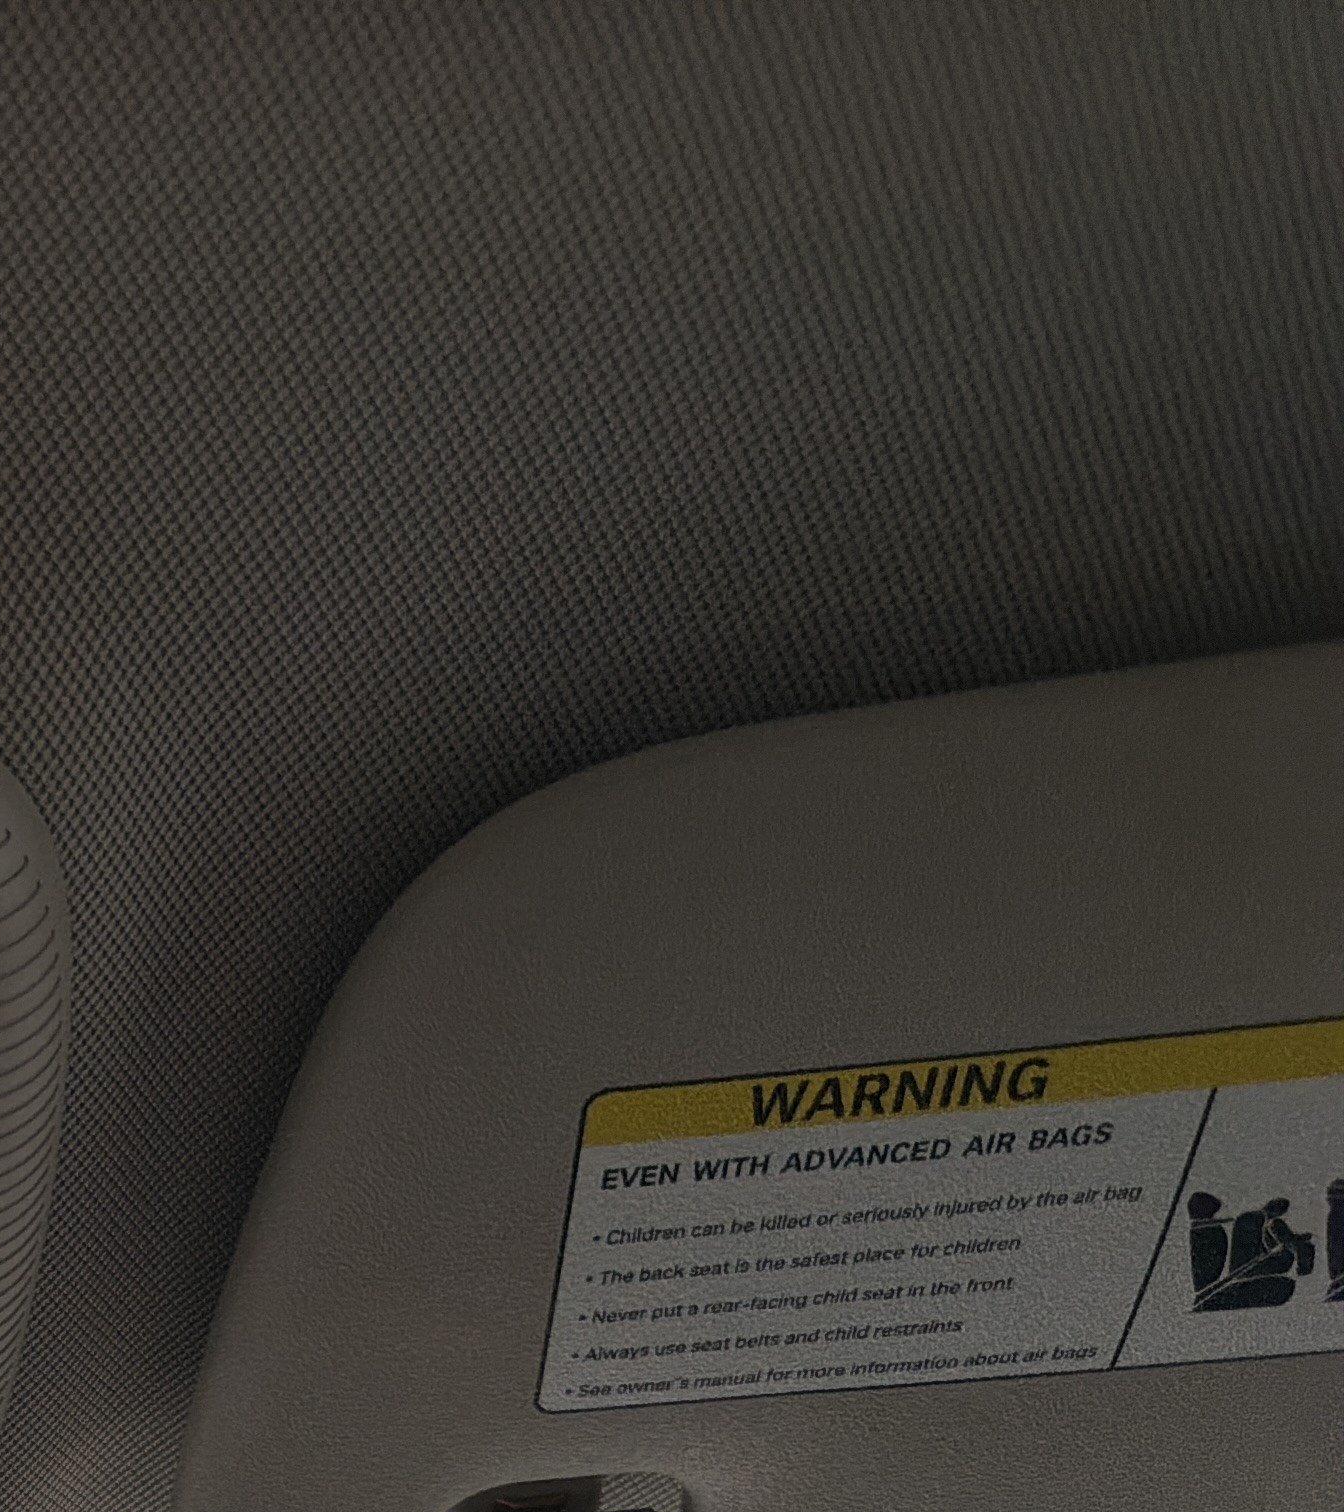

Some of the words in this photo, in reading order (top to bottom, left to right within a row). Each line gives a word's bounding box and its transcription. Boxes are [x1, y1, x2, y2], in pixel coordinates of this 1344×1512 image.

[750, 1057, 1051, 1127] WARNING
[601, 1163, 680, 1191] EVEN
[693, 1154, 771, 1182] WITH
[780, 1138, 951, 1174] ADVANCED
[962, 1131, 1016, 1157] AIR
[1027, 1121, 1114, 1152] BAGS
[606, 1225, 686, 1246] Children
[691, 1222, 724, 1237] can
[730, 1220, 755, 1234] be
[760, 1215, 811, 1232] killed
[816, 1212, 839, 1227] or
[842, 1204, 930, 1228] seriously
[932, 1195, 1003, 1219] injured
[1006, 1195, 1031, 1212] by
[1036, 1192, 1068, 1207] the
[1072, 1189, 1100, 1204] air
[1102, 1185, 1142, 1204] bag
[600, 1268, 634, 1285] The
[639, 1262, 684, 1282] back
[690, 1262, 729, 1278] seat
[734, 1258, 750, 1273] is
[755, 1255, 785, 1272] the
[789, 1251, 848, 1270] safest
[853, 1246, 905, 1265] place
[910, 1244, 939, 1259] for
[943, 1237, 1021, 1257] children
[592, 1308, 648, 1324] Never
[651, 1304, 684, 1322] put
[687, 1304, 700, 1316] a
[813, 1287, 858, 1306] child
[861, 1285, 903, 1302] seat
[908, 1283, 925, 1297] in
[930, 1280, 962, 1296] the
[966, 1276, 1014, 1294] front
[585, 1344, 650, 1364] Always
[654, 1342, 688, 1356] use
[691, 1339, 731, 1354] seat
[734, 1333, 781, 1350] belts
[784, 1330, 820, 1346] and
[825, 1325, 870, 1342] child
[872, 1318, 964, 1339] restraints
[578, 1383, 612, 1398] See
[694, 1370, 762, 1390] manual
[766, 1368, 793, 1383] for
[796, 1366, 846, 1380] more
[850, 1357, 958, 1376] information
[963, 1351, 1019, 1367] about
[1022, 1349, 1048, 1363] air
[1050, 1344, 1098, 1361] bags
